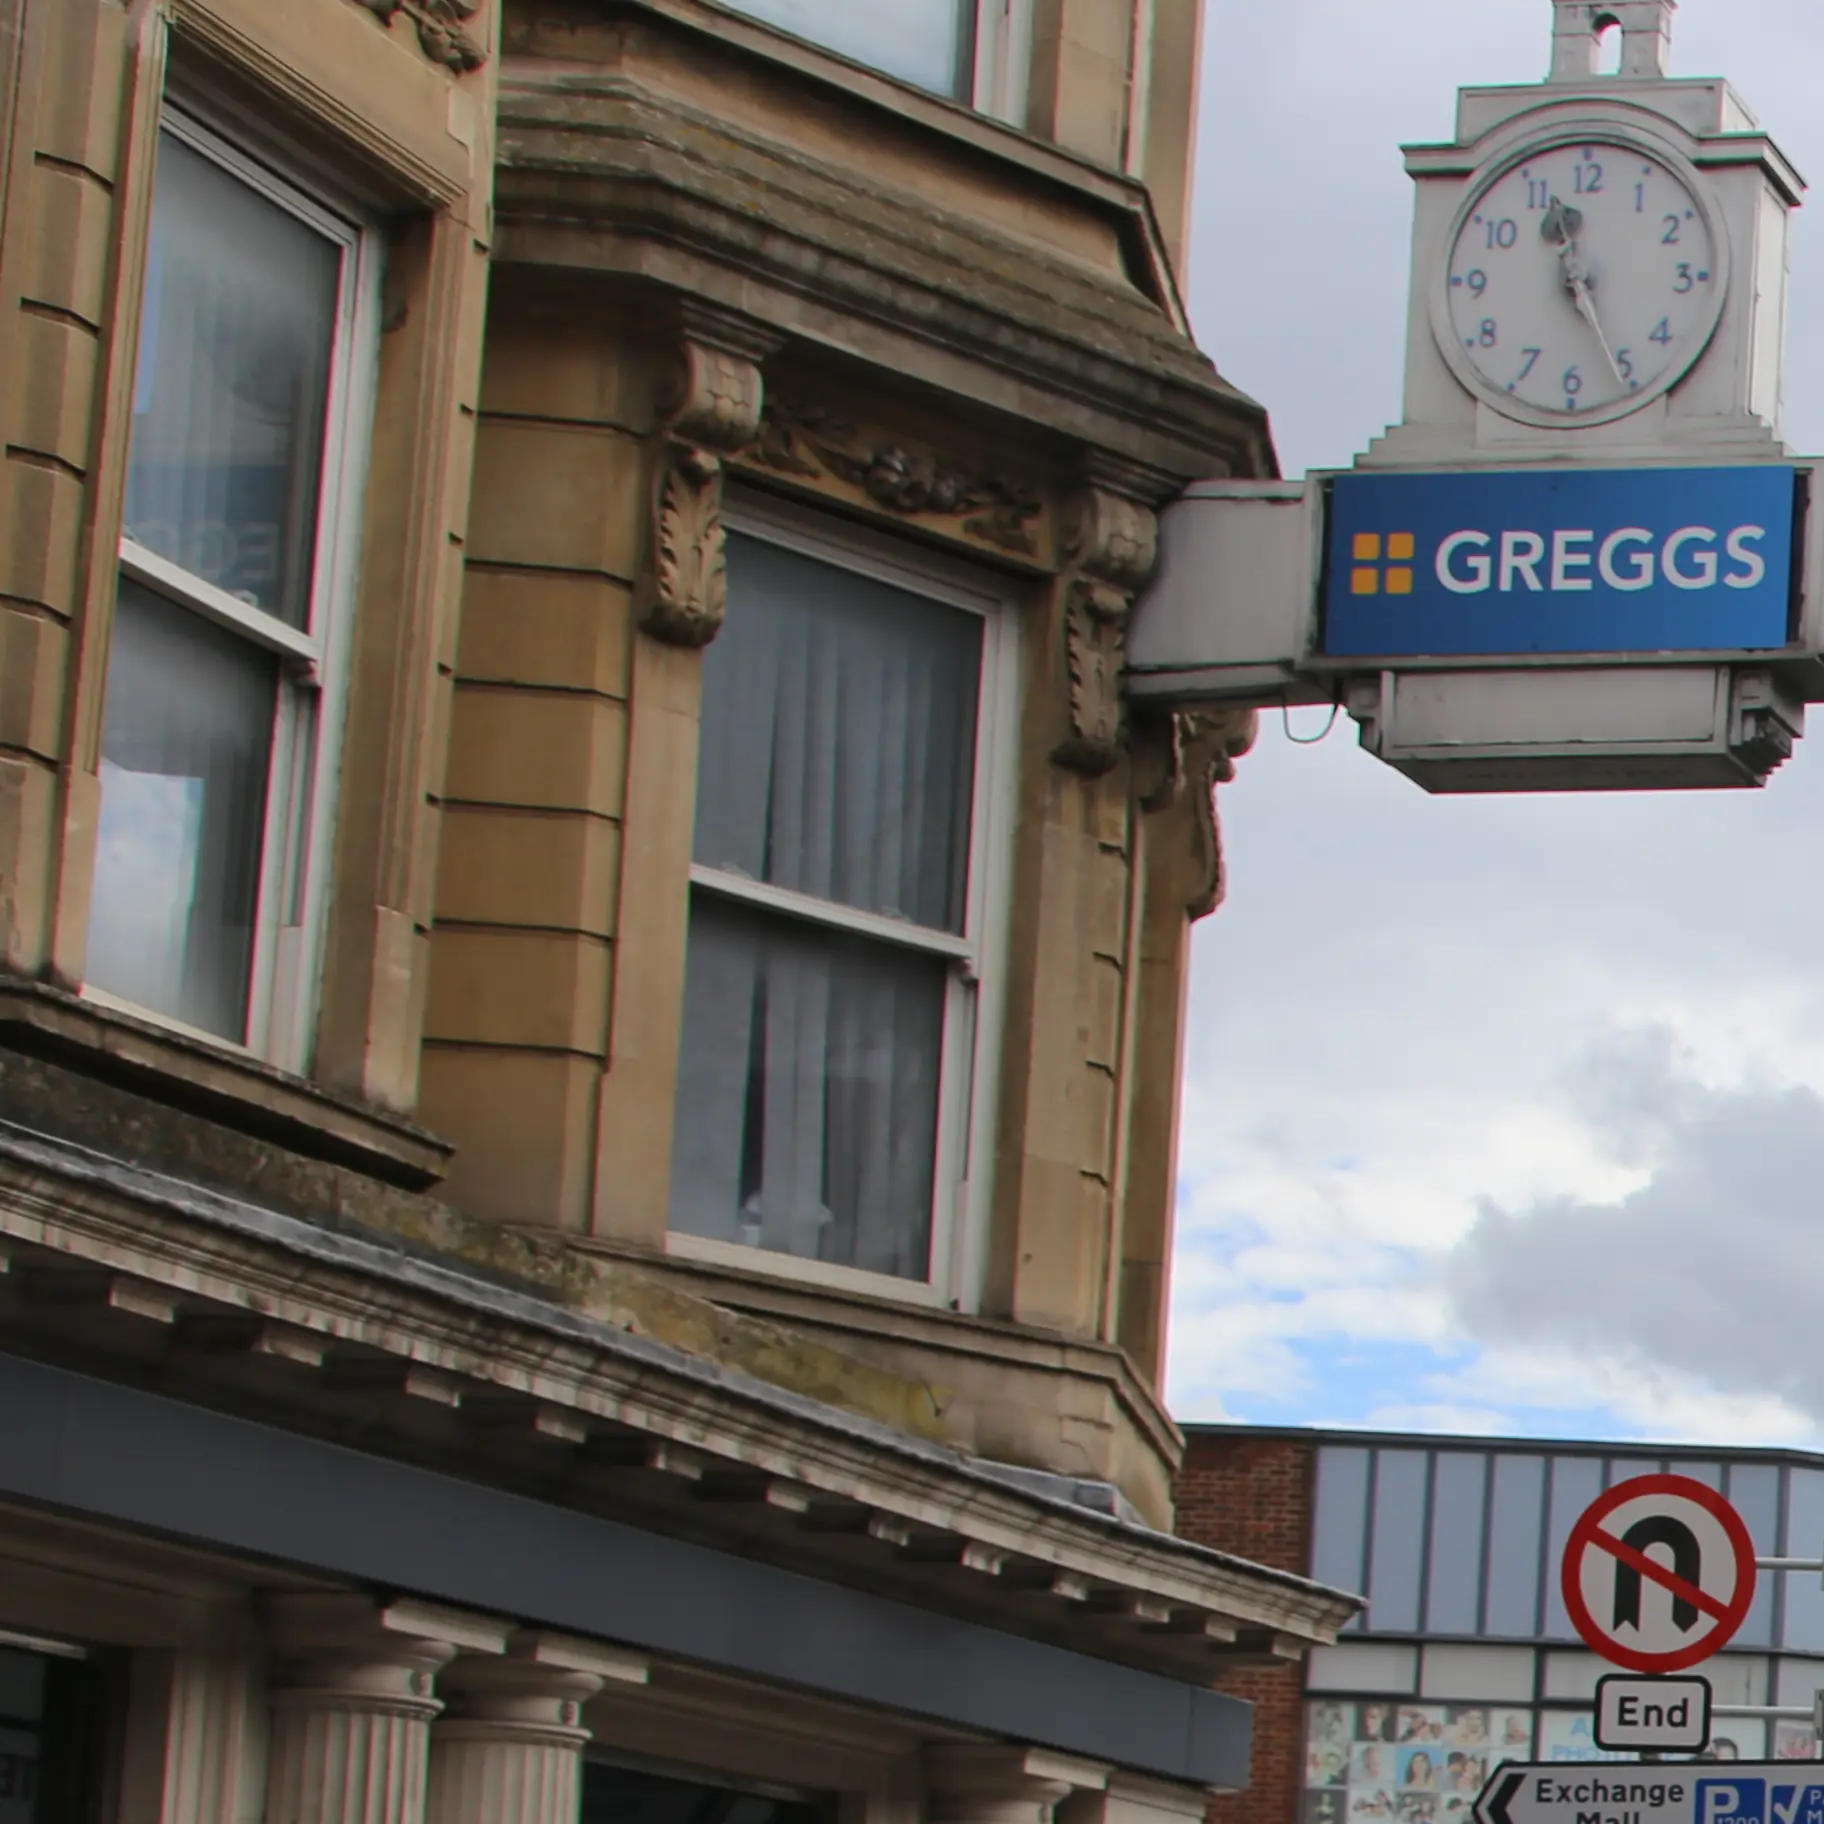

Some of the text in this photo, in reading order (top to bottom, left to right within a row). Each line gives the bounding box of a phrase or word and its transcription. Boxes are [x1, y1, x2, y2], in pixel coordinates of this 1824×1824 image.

[1574, 164, 1603, 193] 12
[1633, 184, 1645, 211] 1
[1486, 219, 1517, 249] 10
[1661, 215, 1680, 244] 2
[1468, 270, 1488, 299] 9
[1673, 264, 1692, 293] 3
[1479, 319, 1497, 348] 8
[1648, 317, 1673, 345] 4
[1520, 349, 1541, 379] 7
[1617, 350, 1633, 378] 5
[1562, 366, 1581, 394] 6
[1436, 525, 1766, 594] GREGGS
[1618, 1696, 1689, 1728] End
[1535, 1778, 1684, 1807] Exchange
